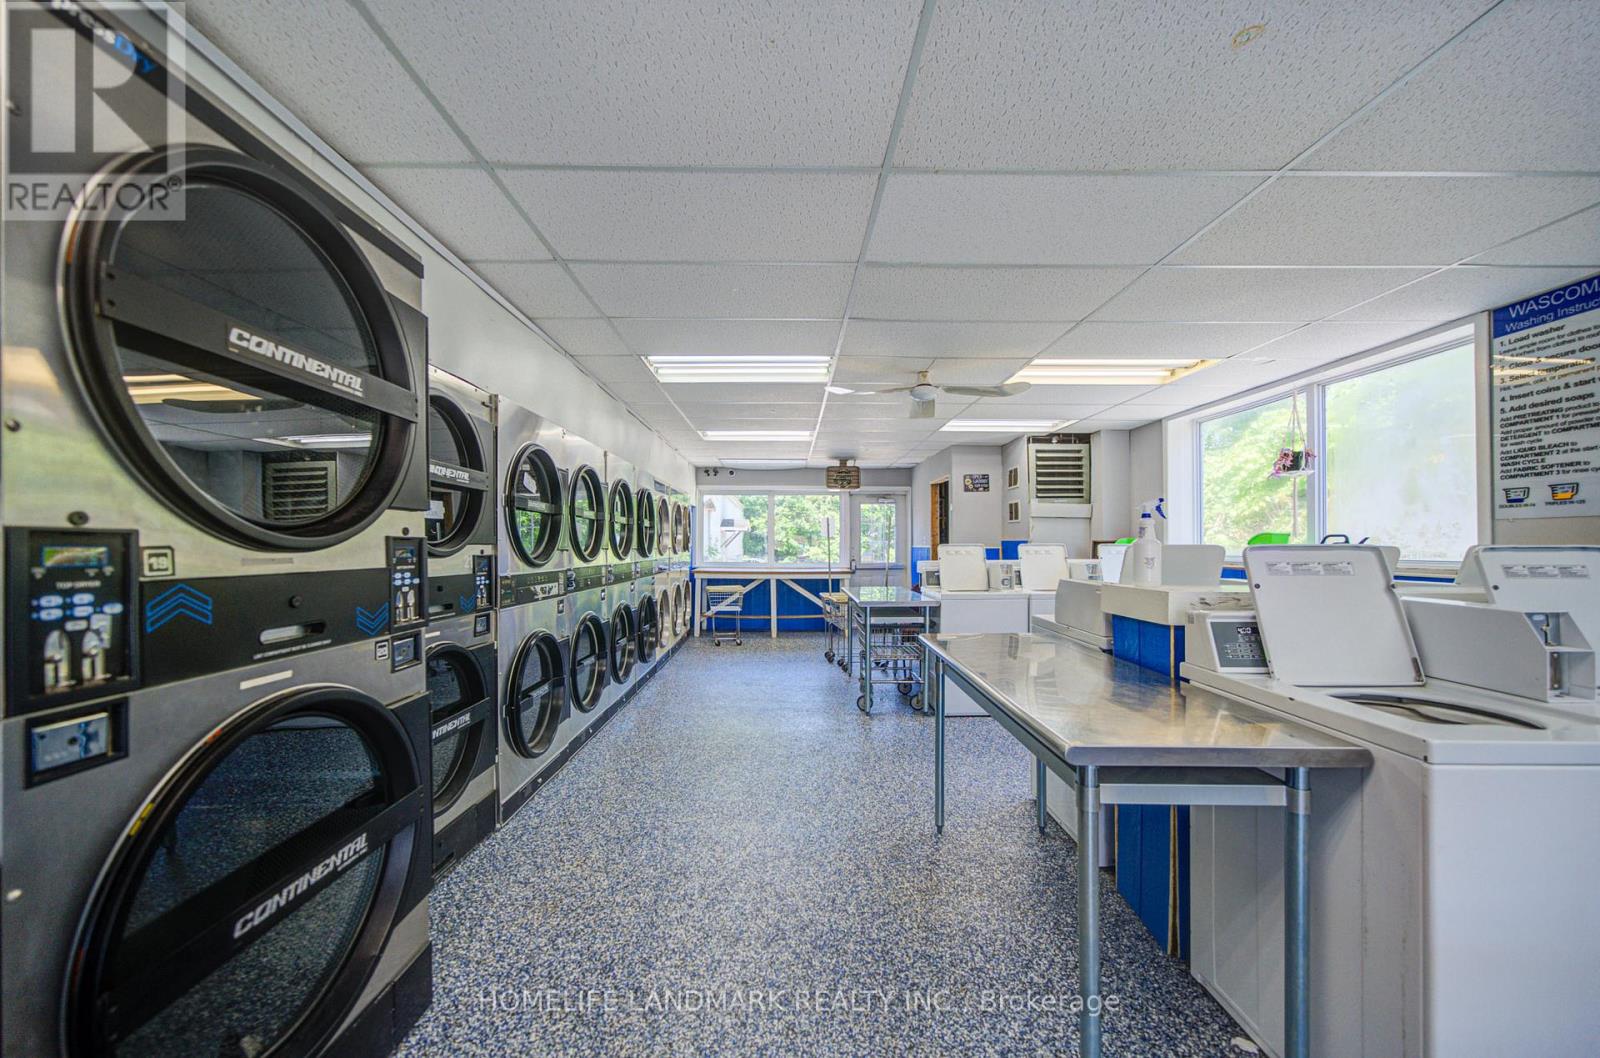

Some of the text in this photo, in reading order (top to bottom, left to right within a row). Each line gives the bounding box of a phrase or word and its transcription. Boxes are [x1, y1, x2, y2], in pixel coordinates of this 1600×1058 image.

[1509, 279, 1600, 318] WASCOM
[1505, 299, 1600, 333] Washing Instruc
[1508, 334, 1530, 345] Load
[1532, 324, 1566, 338] washer
[229, 327, 363, 391] CONTINENTAL
[1508, 359, 1533, 370] Close
[1579, 343, 1600, 353] doo
[1509, 390, 1534, 401] Insert
[1535, 385, 1562, 395] coins
[1573, 376, 1596, 388] start
[1508, 403, 1527, 413] Add
[1528, 397, 1562, 409] desired
[1564, 392, 1595, 403] soaps
[1500, 415, 1554, 429] COMPARTMENT
[1500, 450, 1554, 462] COMPARTMENT
[1538, 441, 1570, 451] BLEACH
[1500, 458, 1546, 468] WASH CYCLE
[1513, 465, 1539, 473] FABRIC
[1540, 460, 1582, 470] SOFTENER
[1500, 470, 1554, 481] COMPARTMENT
[233, 832, 368, 939] CONTINENTAL
